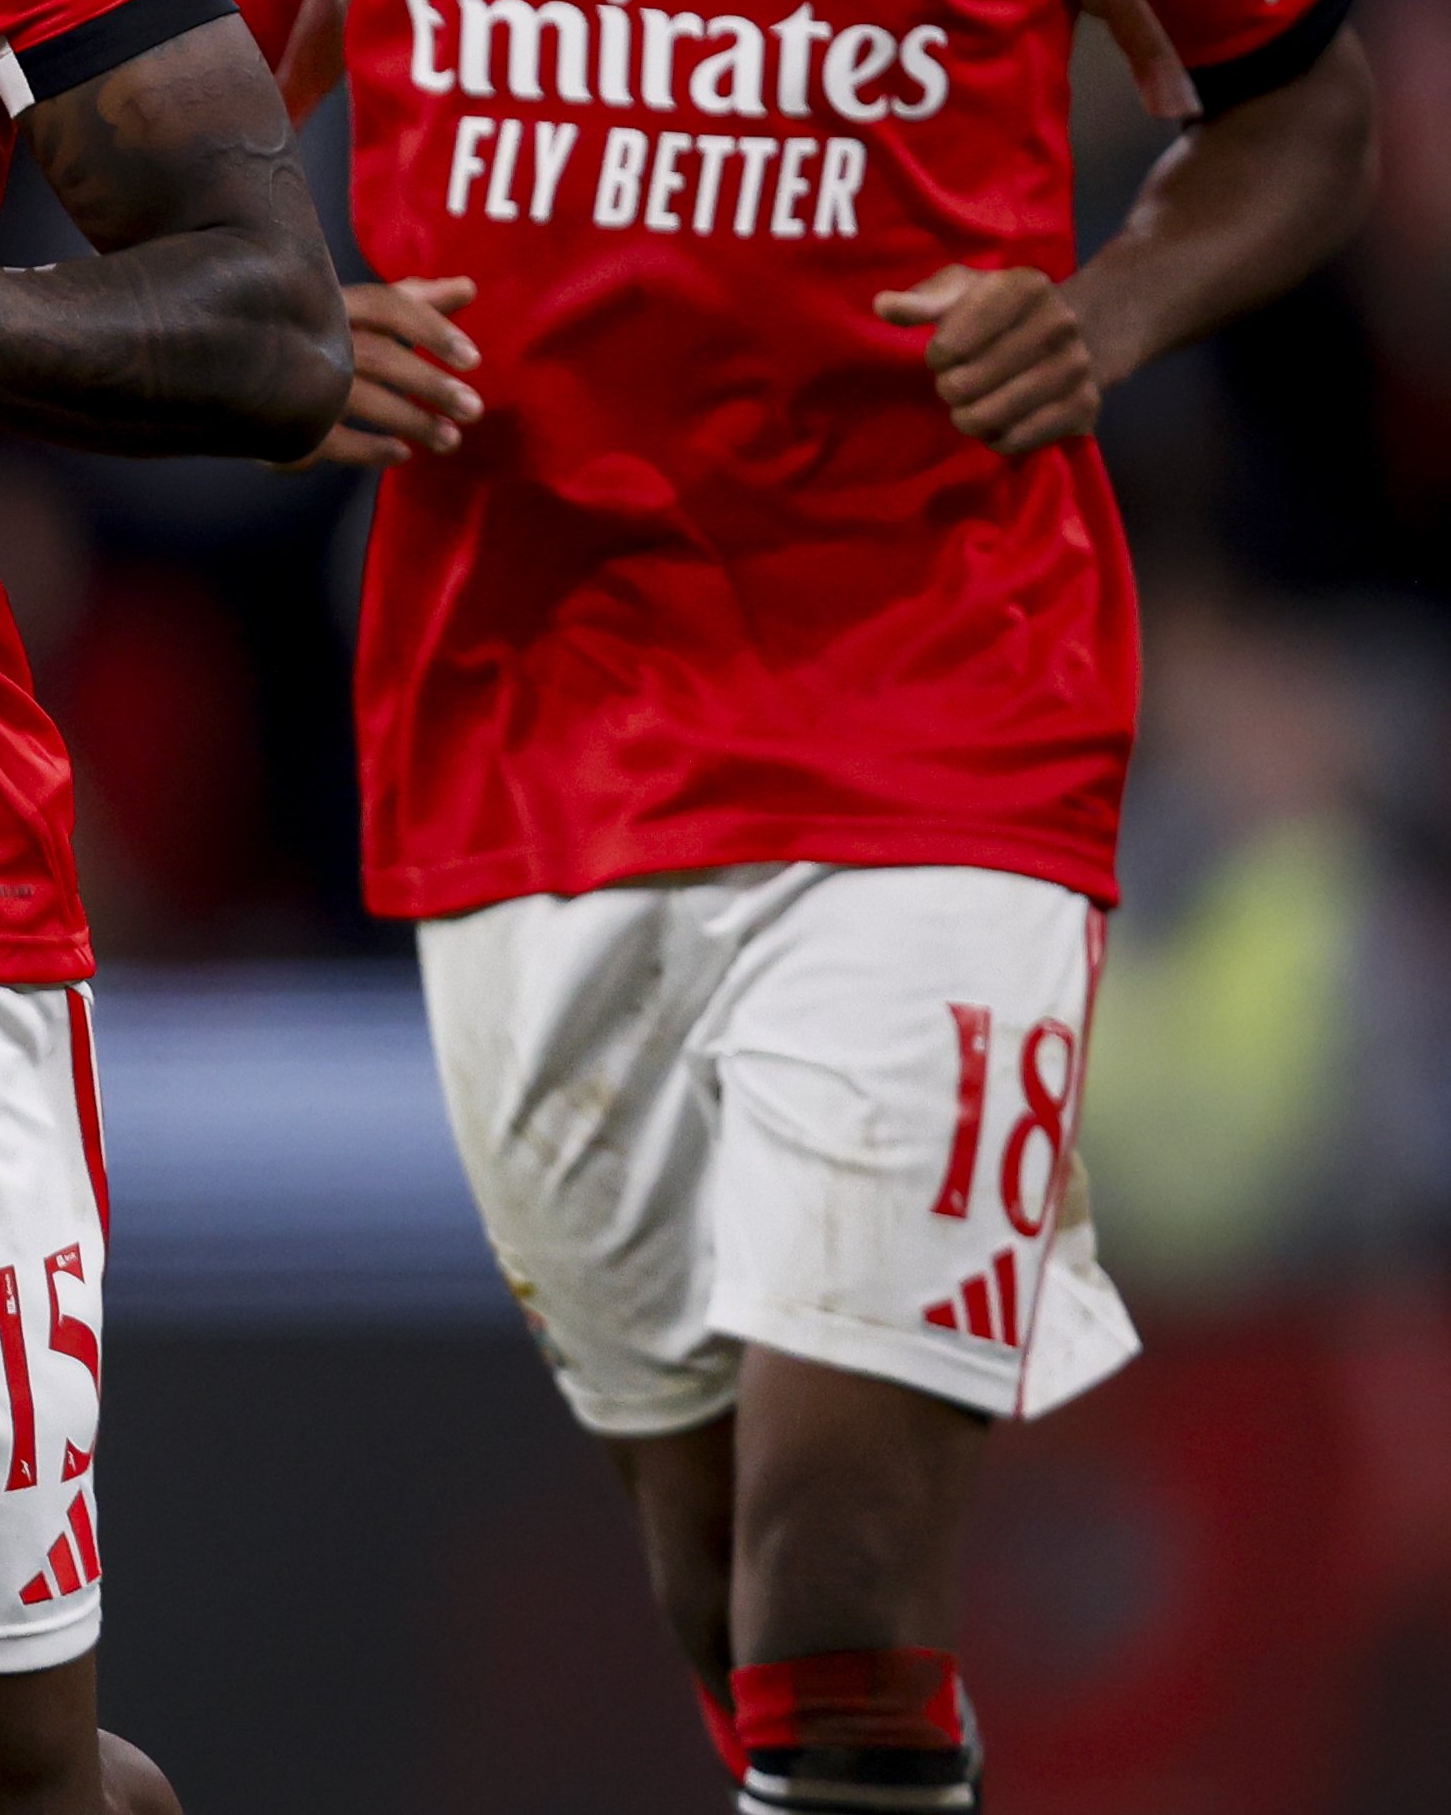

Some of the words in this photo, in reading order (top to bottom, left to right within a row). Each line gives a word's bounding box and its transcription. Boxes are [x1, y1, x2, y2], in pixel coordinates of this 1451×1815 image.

[446, 115, 578, 222] FLY
[593, 127, 866, 238] BETTER
[931, 1000, 1075, 1239] 18
